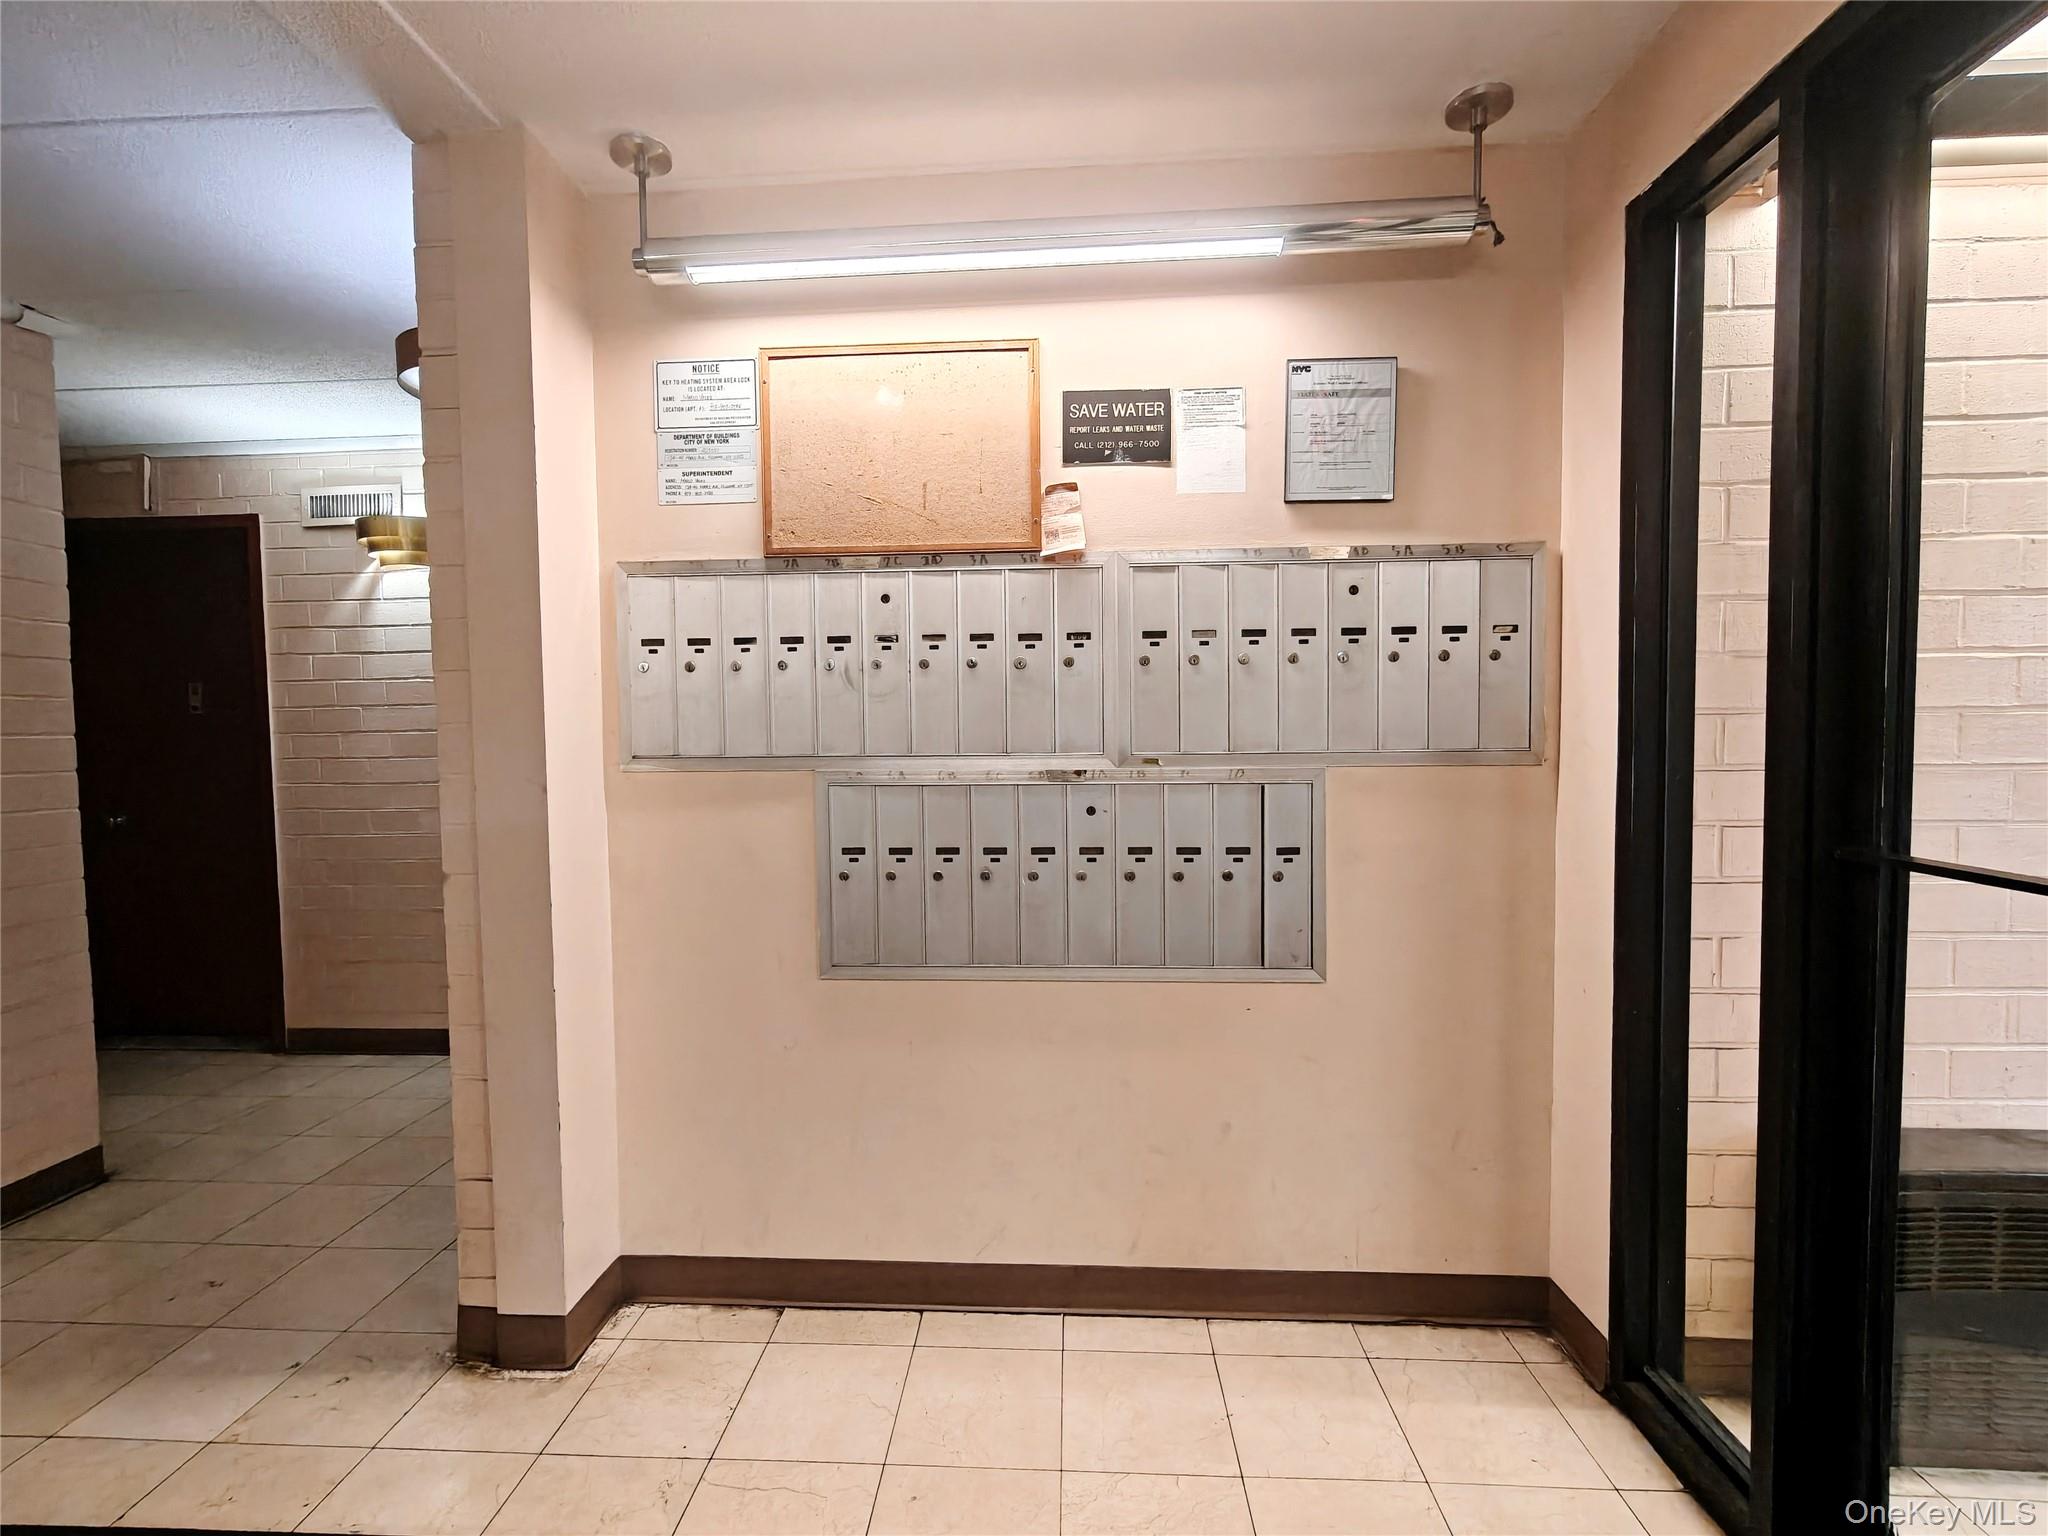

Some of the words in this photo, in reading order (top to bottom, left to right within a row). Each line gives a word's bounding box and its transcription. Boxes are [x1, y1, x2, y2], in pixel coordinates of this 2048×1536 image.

[692, 364, 720, 373] NOTICE
[1069, 403, 1109, 418] SAVE
[1112, 402, 1165, 418] WATER
[1069, 426, 1090, 434] REPORT
[1092, 425, 1110, 434] LEAKS
[1112, 425, 1124, 433] AND
[1125, 425, 1144, 433] WATER
[1146, 424, 1165, 432] WASTE
[673, 433, 705, 441] DEPARTMENT
[1074, 441, 1093, 449] CALL
[1097, 441, 1115, 449] (212)
[1118, 440, 1160, 448] 966-7500
